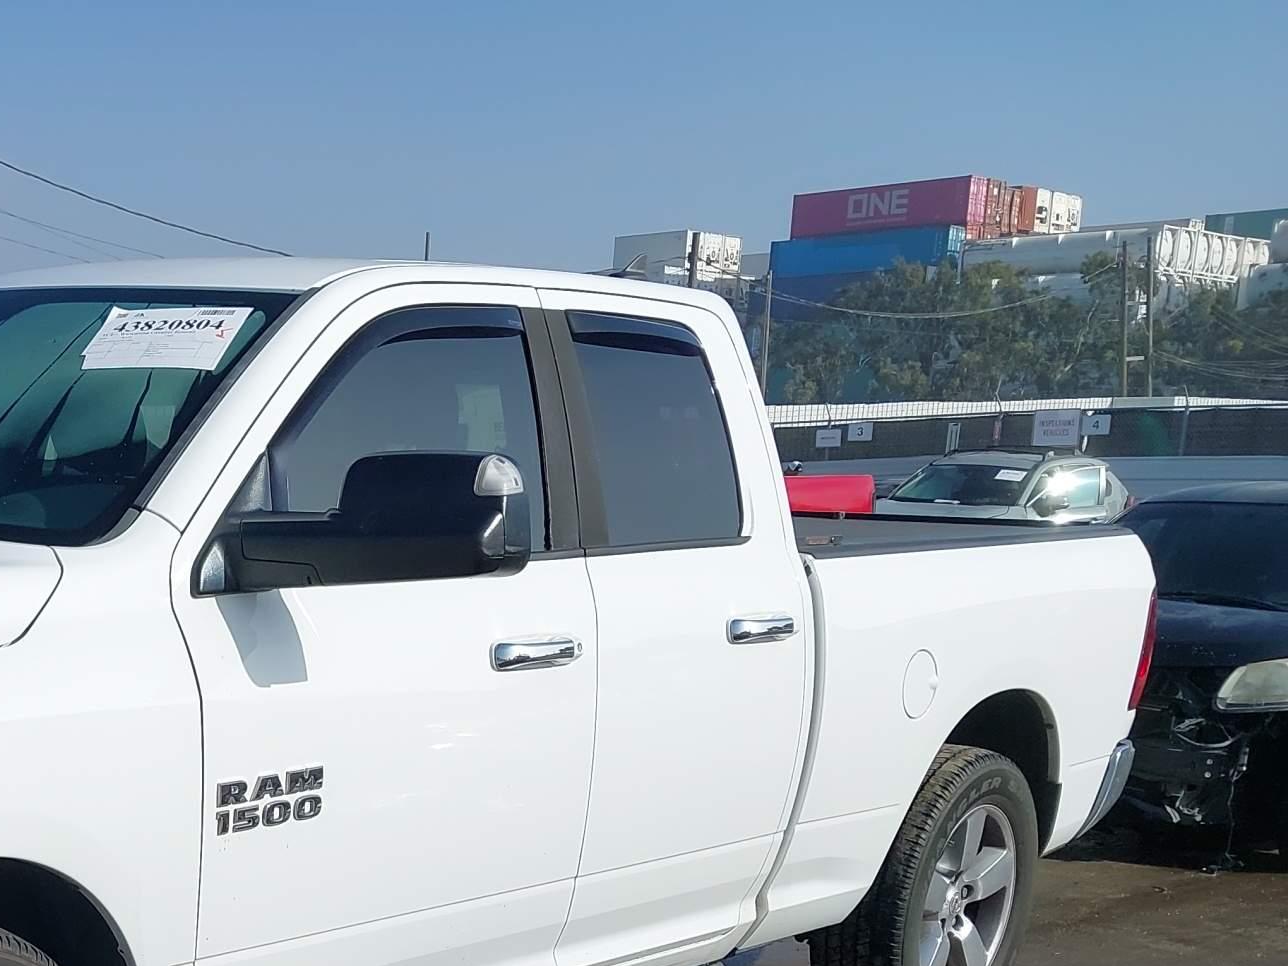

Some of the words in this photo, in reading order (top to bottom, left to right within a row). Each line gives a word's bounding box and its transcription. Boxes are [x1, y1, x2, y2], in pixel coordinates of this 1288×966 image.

[847, 189, 909, 218] ONE
[114, 319, 225, 332] 43820804
[857, 427, 864, 437] 3
[1092, 420, 1100, 429] 4
[216, 765, 324, 808] RAM
[216, 795, 323, 837] 1500
